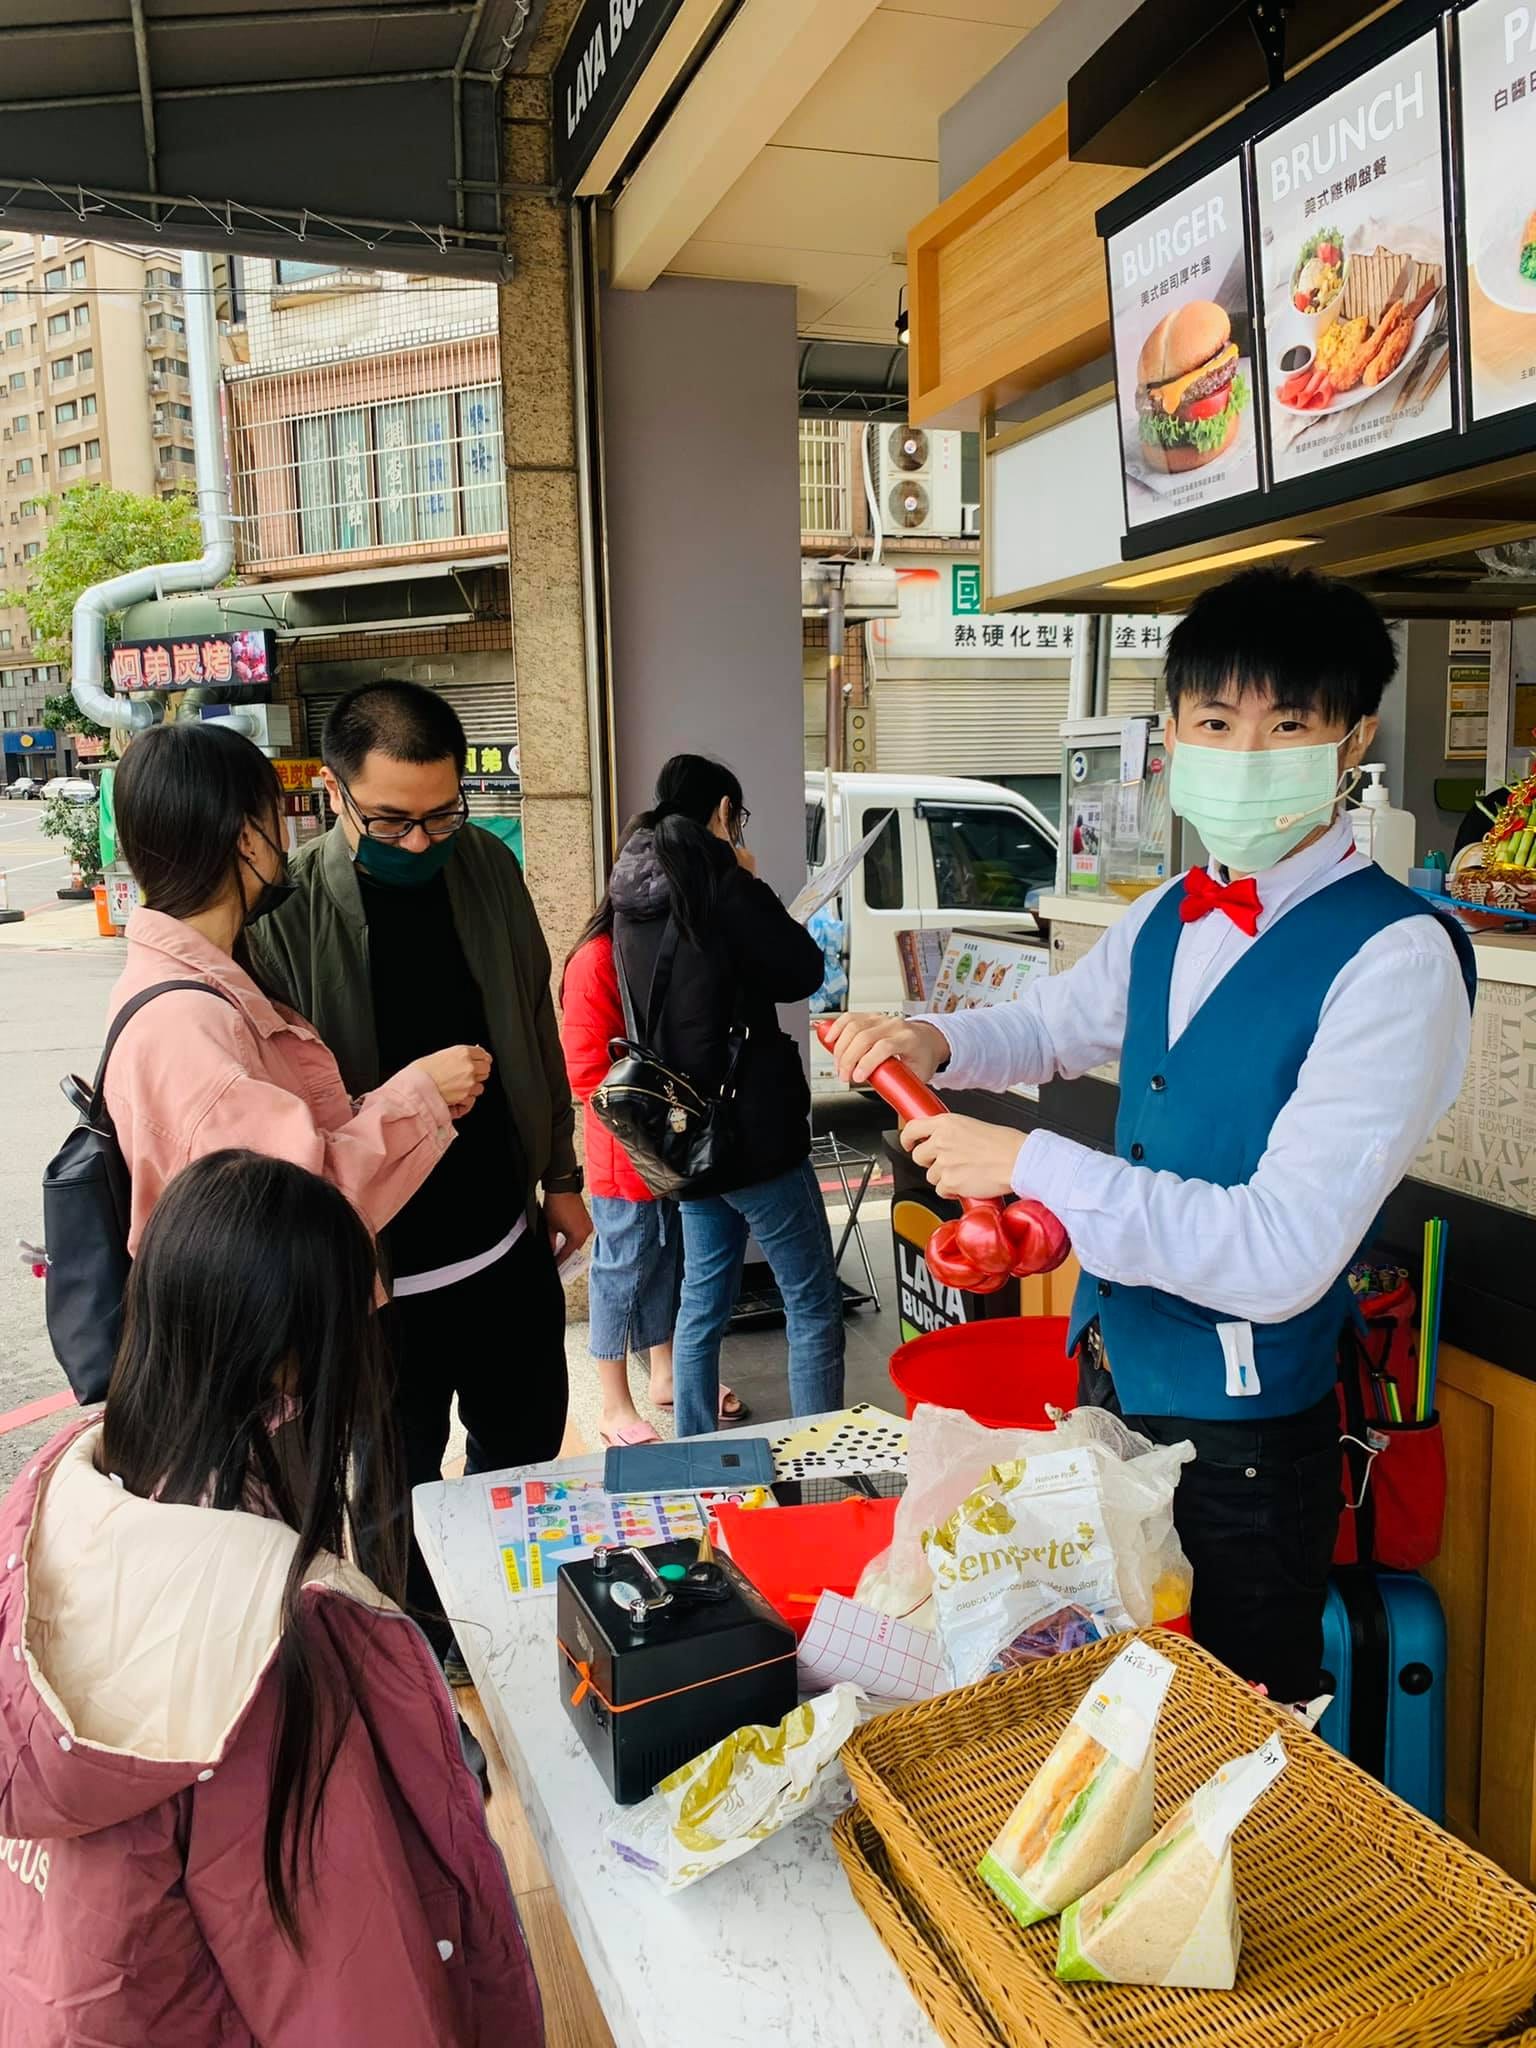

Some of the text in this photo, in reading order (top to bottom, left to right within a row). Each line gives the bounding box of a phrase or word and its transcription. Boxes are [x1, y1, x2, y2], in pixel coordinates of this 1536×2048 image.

[567, 22, 607, 140] LAYA
[1270, 71, 1425, 202] BRUNCH
[1303, 155, 1388, 219] 美式雞柳盤餐
[1120, 195, 1228, 289] BURGER
[1140, 254, 1212, 308] 美式起司厚牛堡
[111, 639, 233, 688] 阿弟炭烤
[1114, 625, 1162, 649] 塗料
[1498, 1017, 1521, 1108] LAYA
[1440, 1149, 1506, 1192] LAYA
